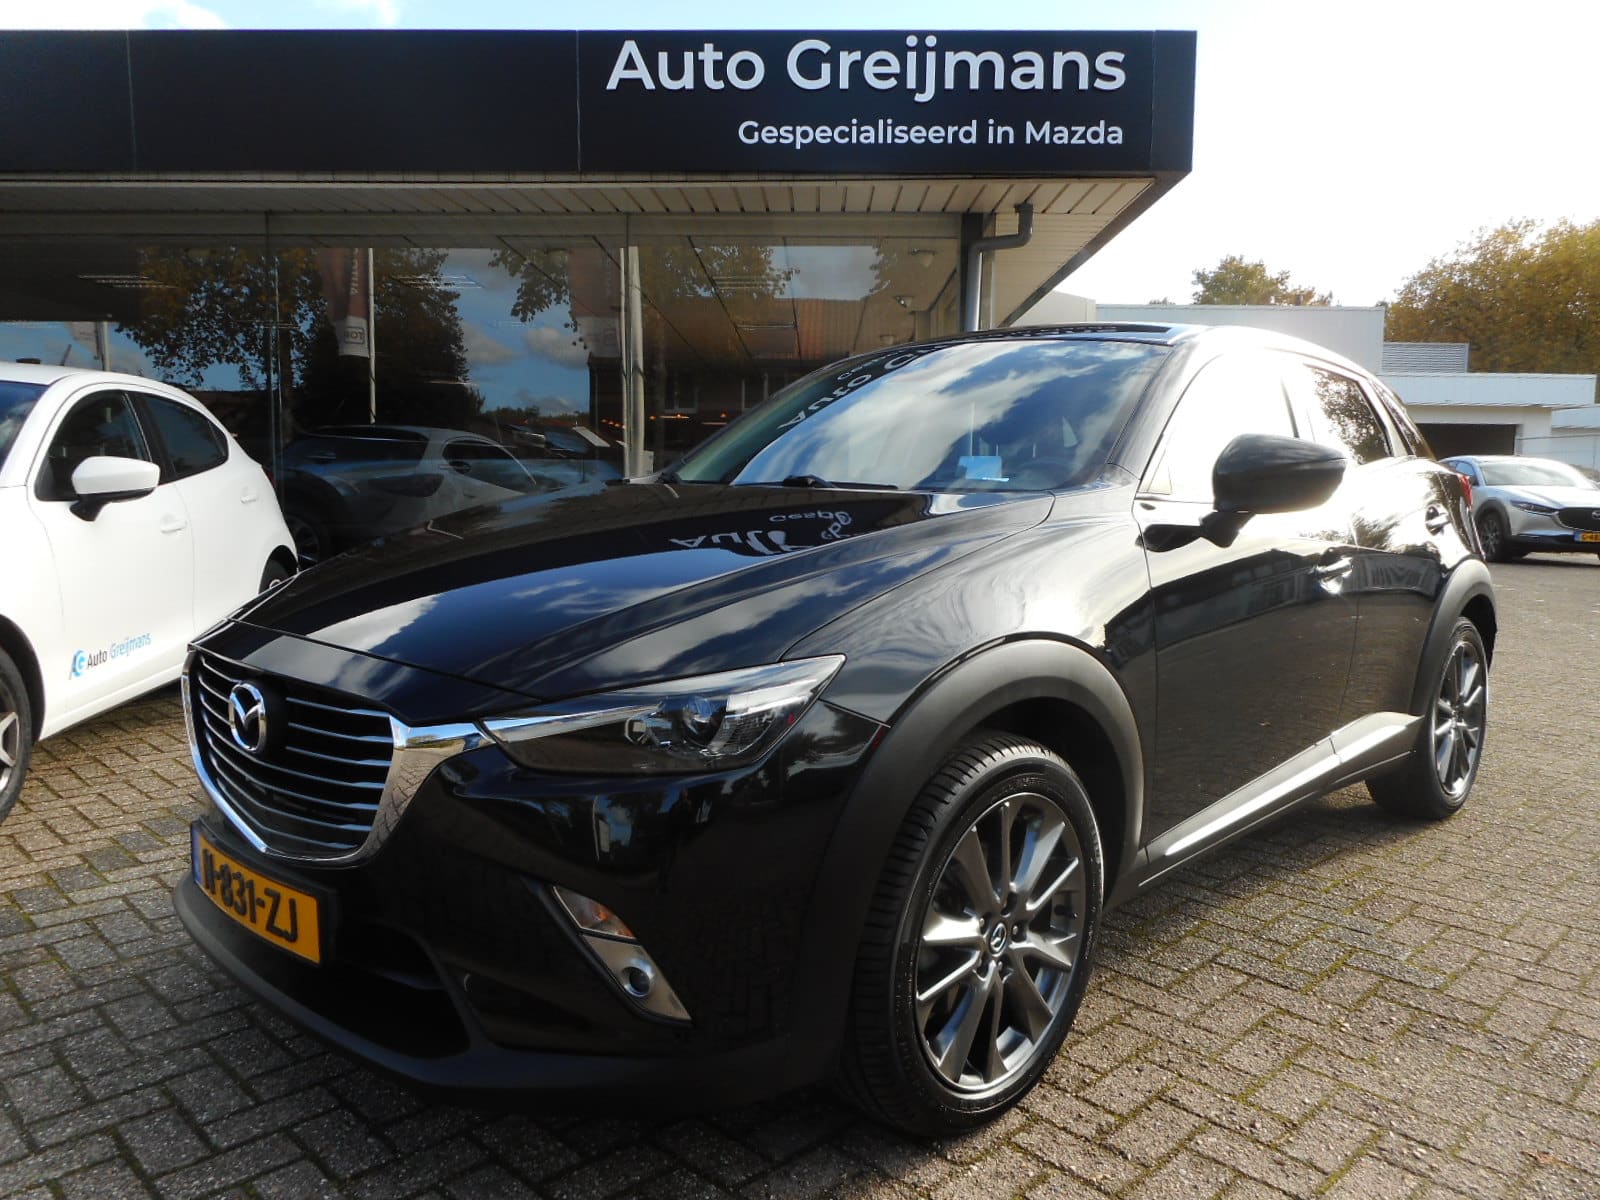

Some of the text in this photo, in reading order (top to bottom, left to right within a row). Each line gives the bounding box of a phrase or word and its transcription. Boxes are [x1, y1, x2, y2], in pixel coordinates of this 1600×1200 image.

[606, 35, 1126, 102] Auto Greijmans
[739, 119, 1122, 149] Gespecialiseerd in Mazda
[87, 649, 108, 669] Auto
[110, 632, 152, 660] Greijmans
